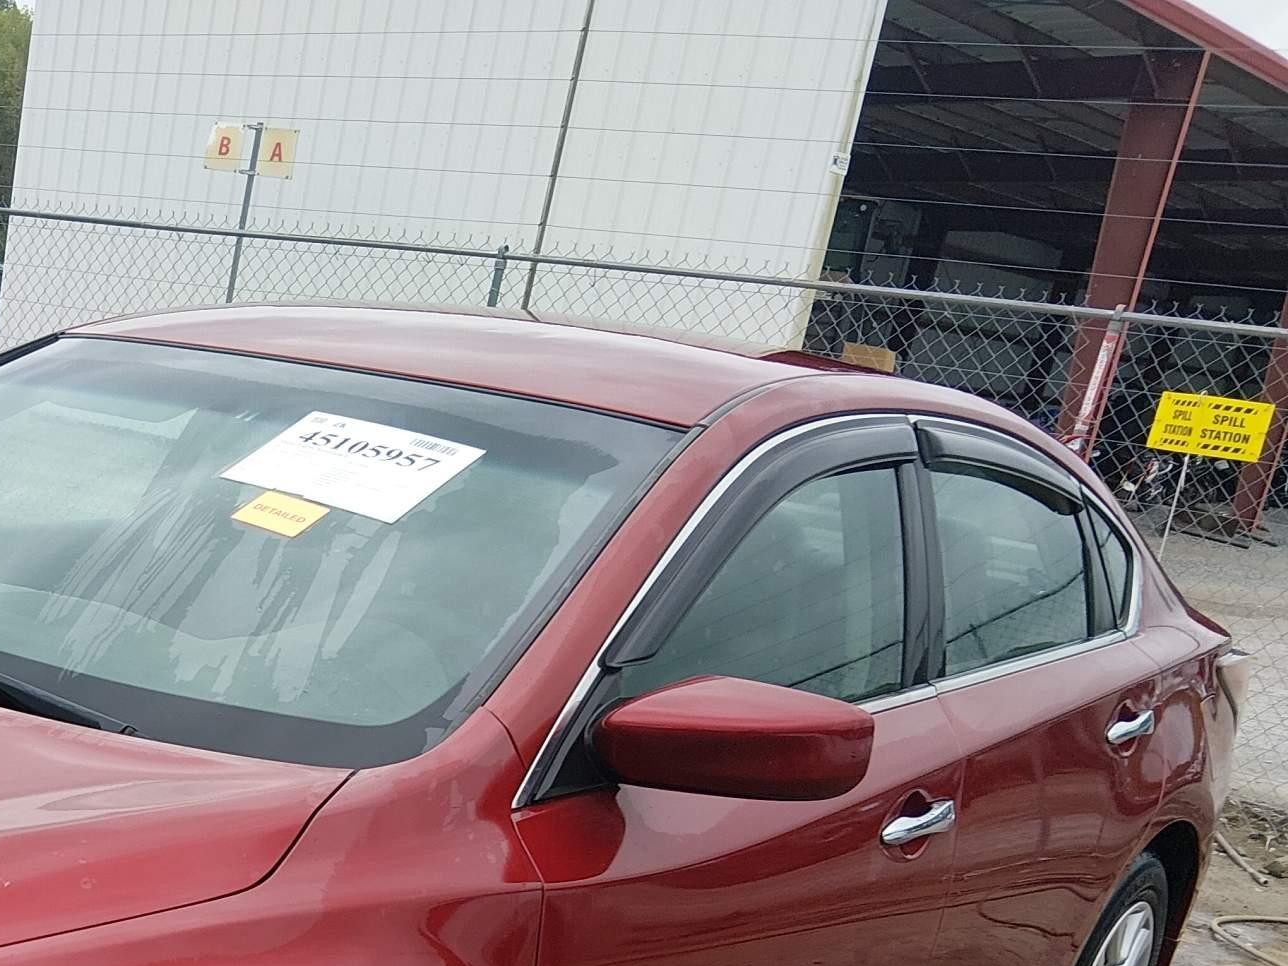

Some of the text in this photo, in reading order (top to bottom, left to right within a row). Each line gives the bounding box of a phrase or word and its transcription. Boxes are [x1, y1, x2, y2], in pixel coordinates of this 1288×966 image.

[218, 136, 231, 156] B
[270, 142, 282, 162] A
[1172, 410, 1192, 421] SPILL
[1212, 414, 1246, 428] SPILL
[1162, 424, 1193, 437] STATION
[1199, 428, 1251, 445] STATION
[297, 430, 441, 472] 45105957
[252, 502, 307, 525] DETAILED
